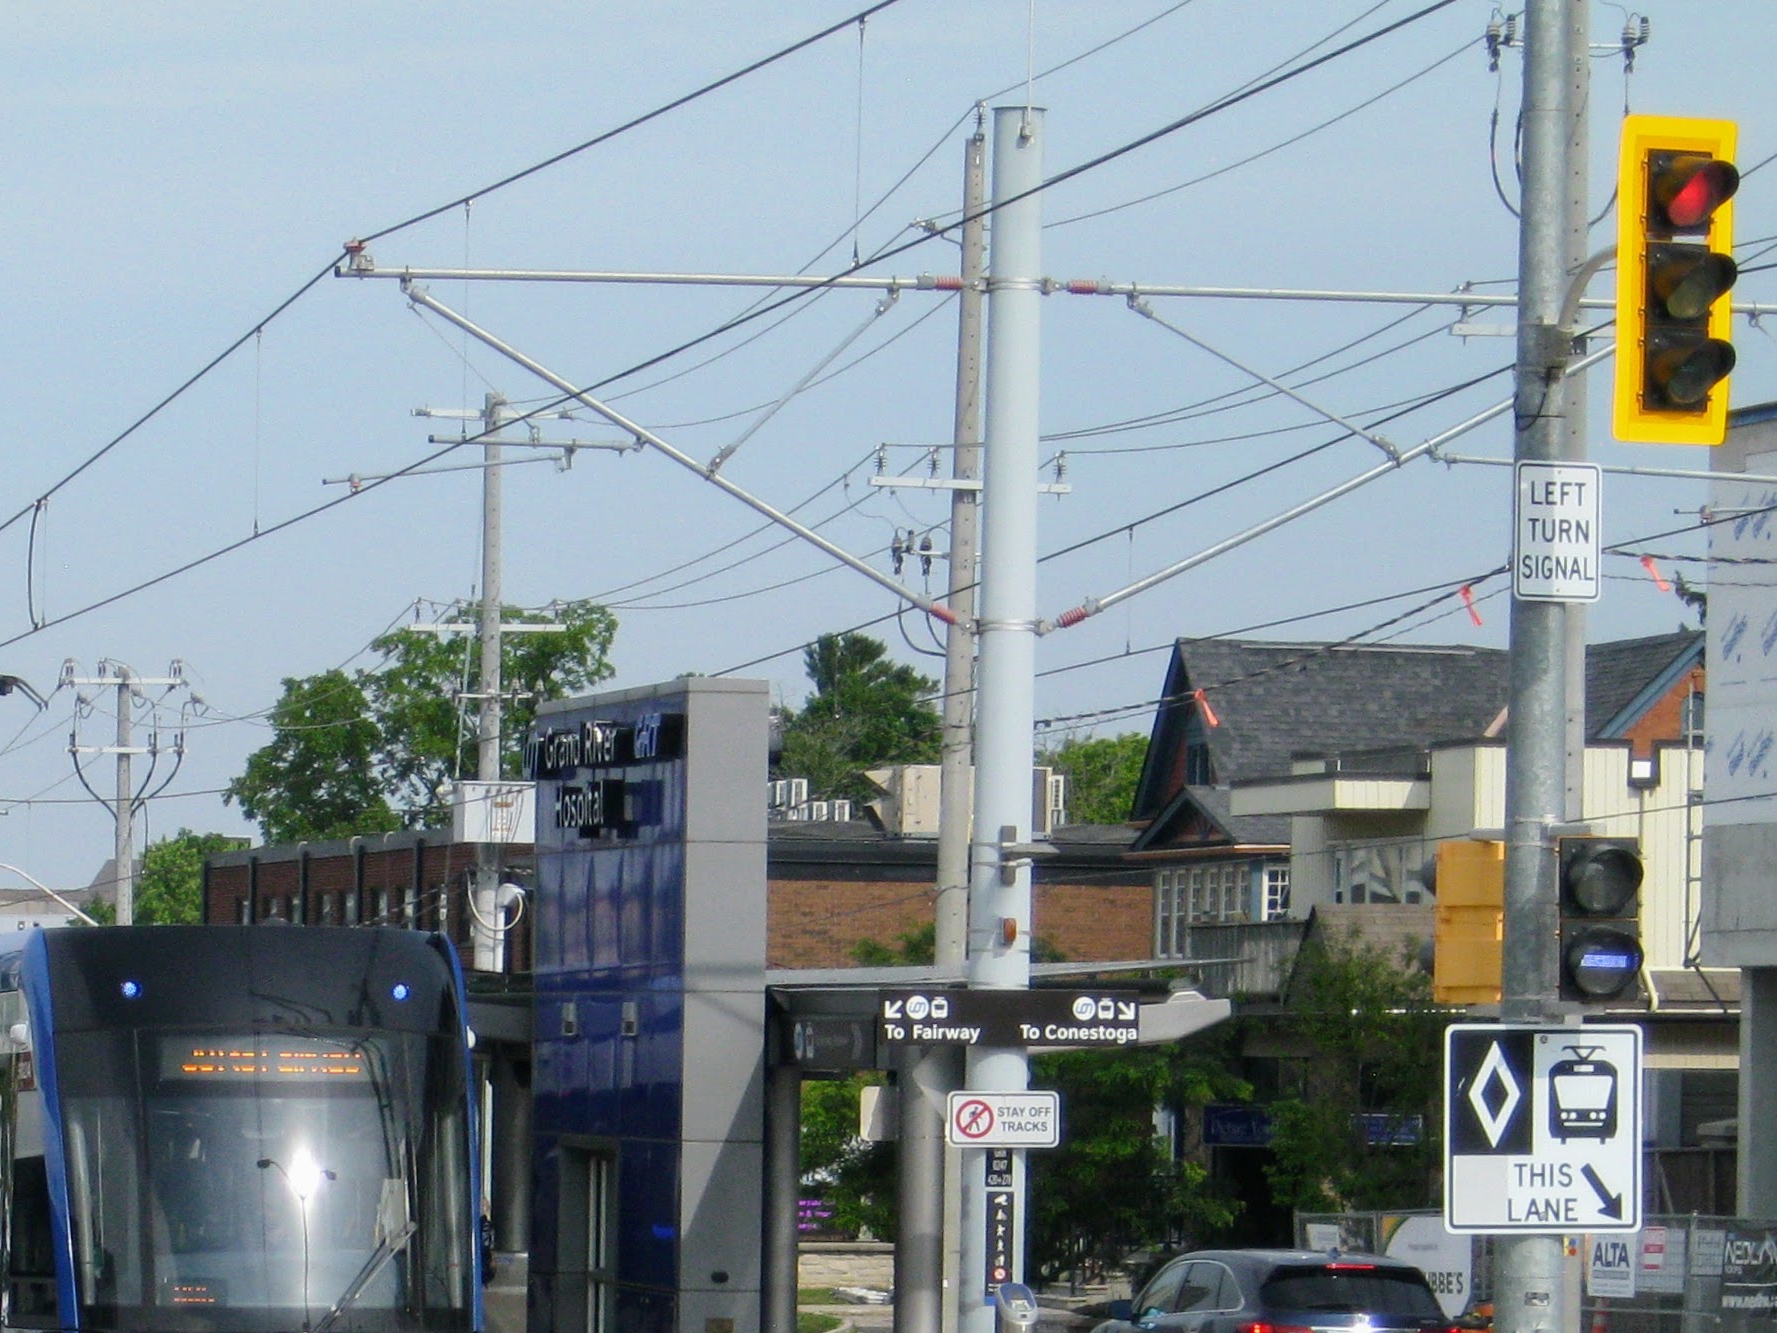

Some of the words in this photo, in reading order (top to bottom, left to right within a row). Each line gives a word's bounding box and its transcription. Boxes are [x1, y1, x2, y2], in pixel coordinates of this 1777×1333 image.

[1531, 480, 1586, 506] LEFT
[1528, 518, 1590, 543] TURN
[1522, 554, 1594, 581] SIGNAL
[544, 727, 581, 769] Grand
[584, 721, 617, 764] River
[555, 780, 604, 828] Hospital
[884, 1024, 905, 1040] To
[912, 1024, 980, 1044] Fairway
[1020, 1024, 1040, 1039] To
[1045, 1024, 1137, 1044] Conestoga
[997, 1106, 1025, 1117] STAY
[1029, 1106, 1051, 1117] OFF
[1001, 1121, 1048, 1131] TRACKS
[1514, 1163, 1573, 1187] THIS
[1508, 1198, 1578, 1222] LANE
[1593, 1242, 1630, 1268] ALTA
